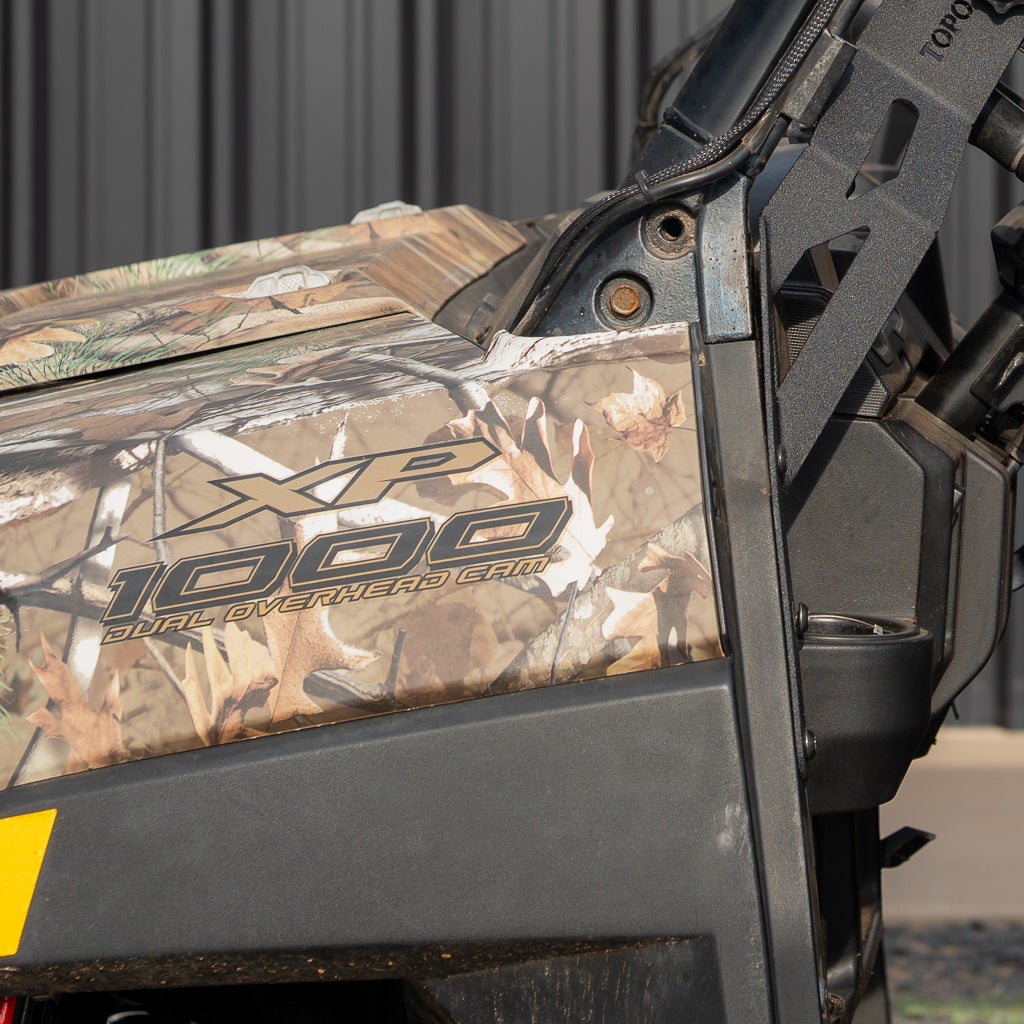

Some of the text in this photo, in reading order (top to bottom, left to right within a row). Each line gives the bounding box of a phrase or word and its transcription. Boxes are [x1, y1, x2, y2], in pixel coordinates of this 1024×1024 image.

[919, 0, 974, 63] TOPO
[147, 436, 502, 542] XP
[100, 495, 574, 626] 1000
[100, 555, 551, 646] DUAL OVERHEAD CAM
